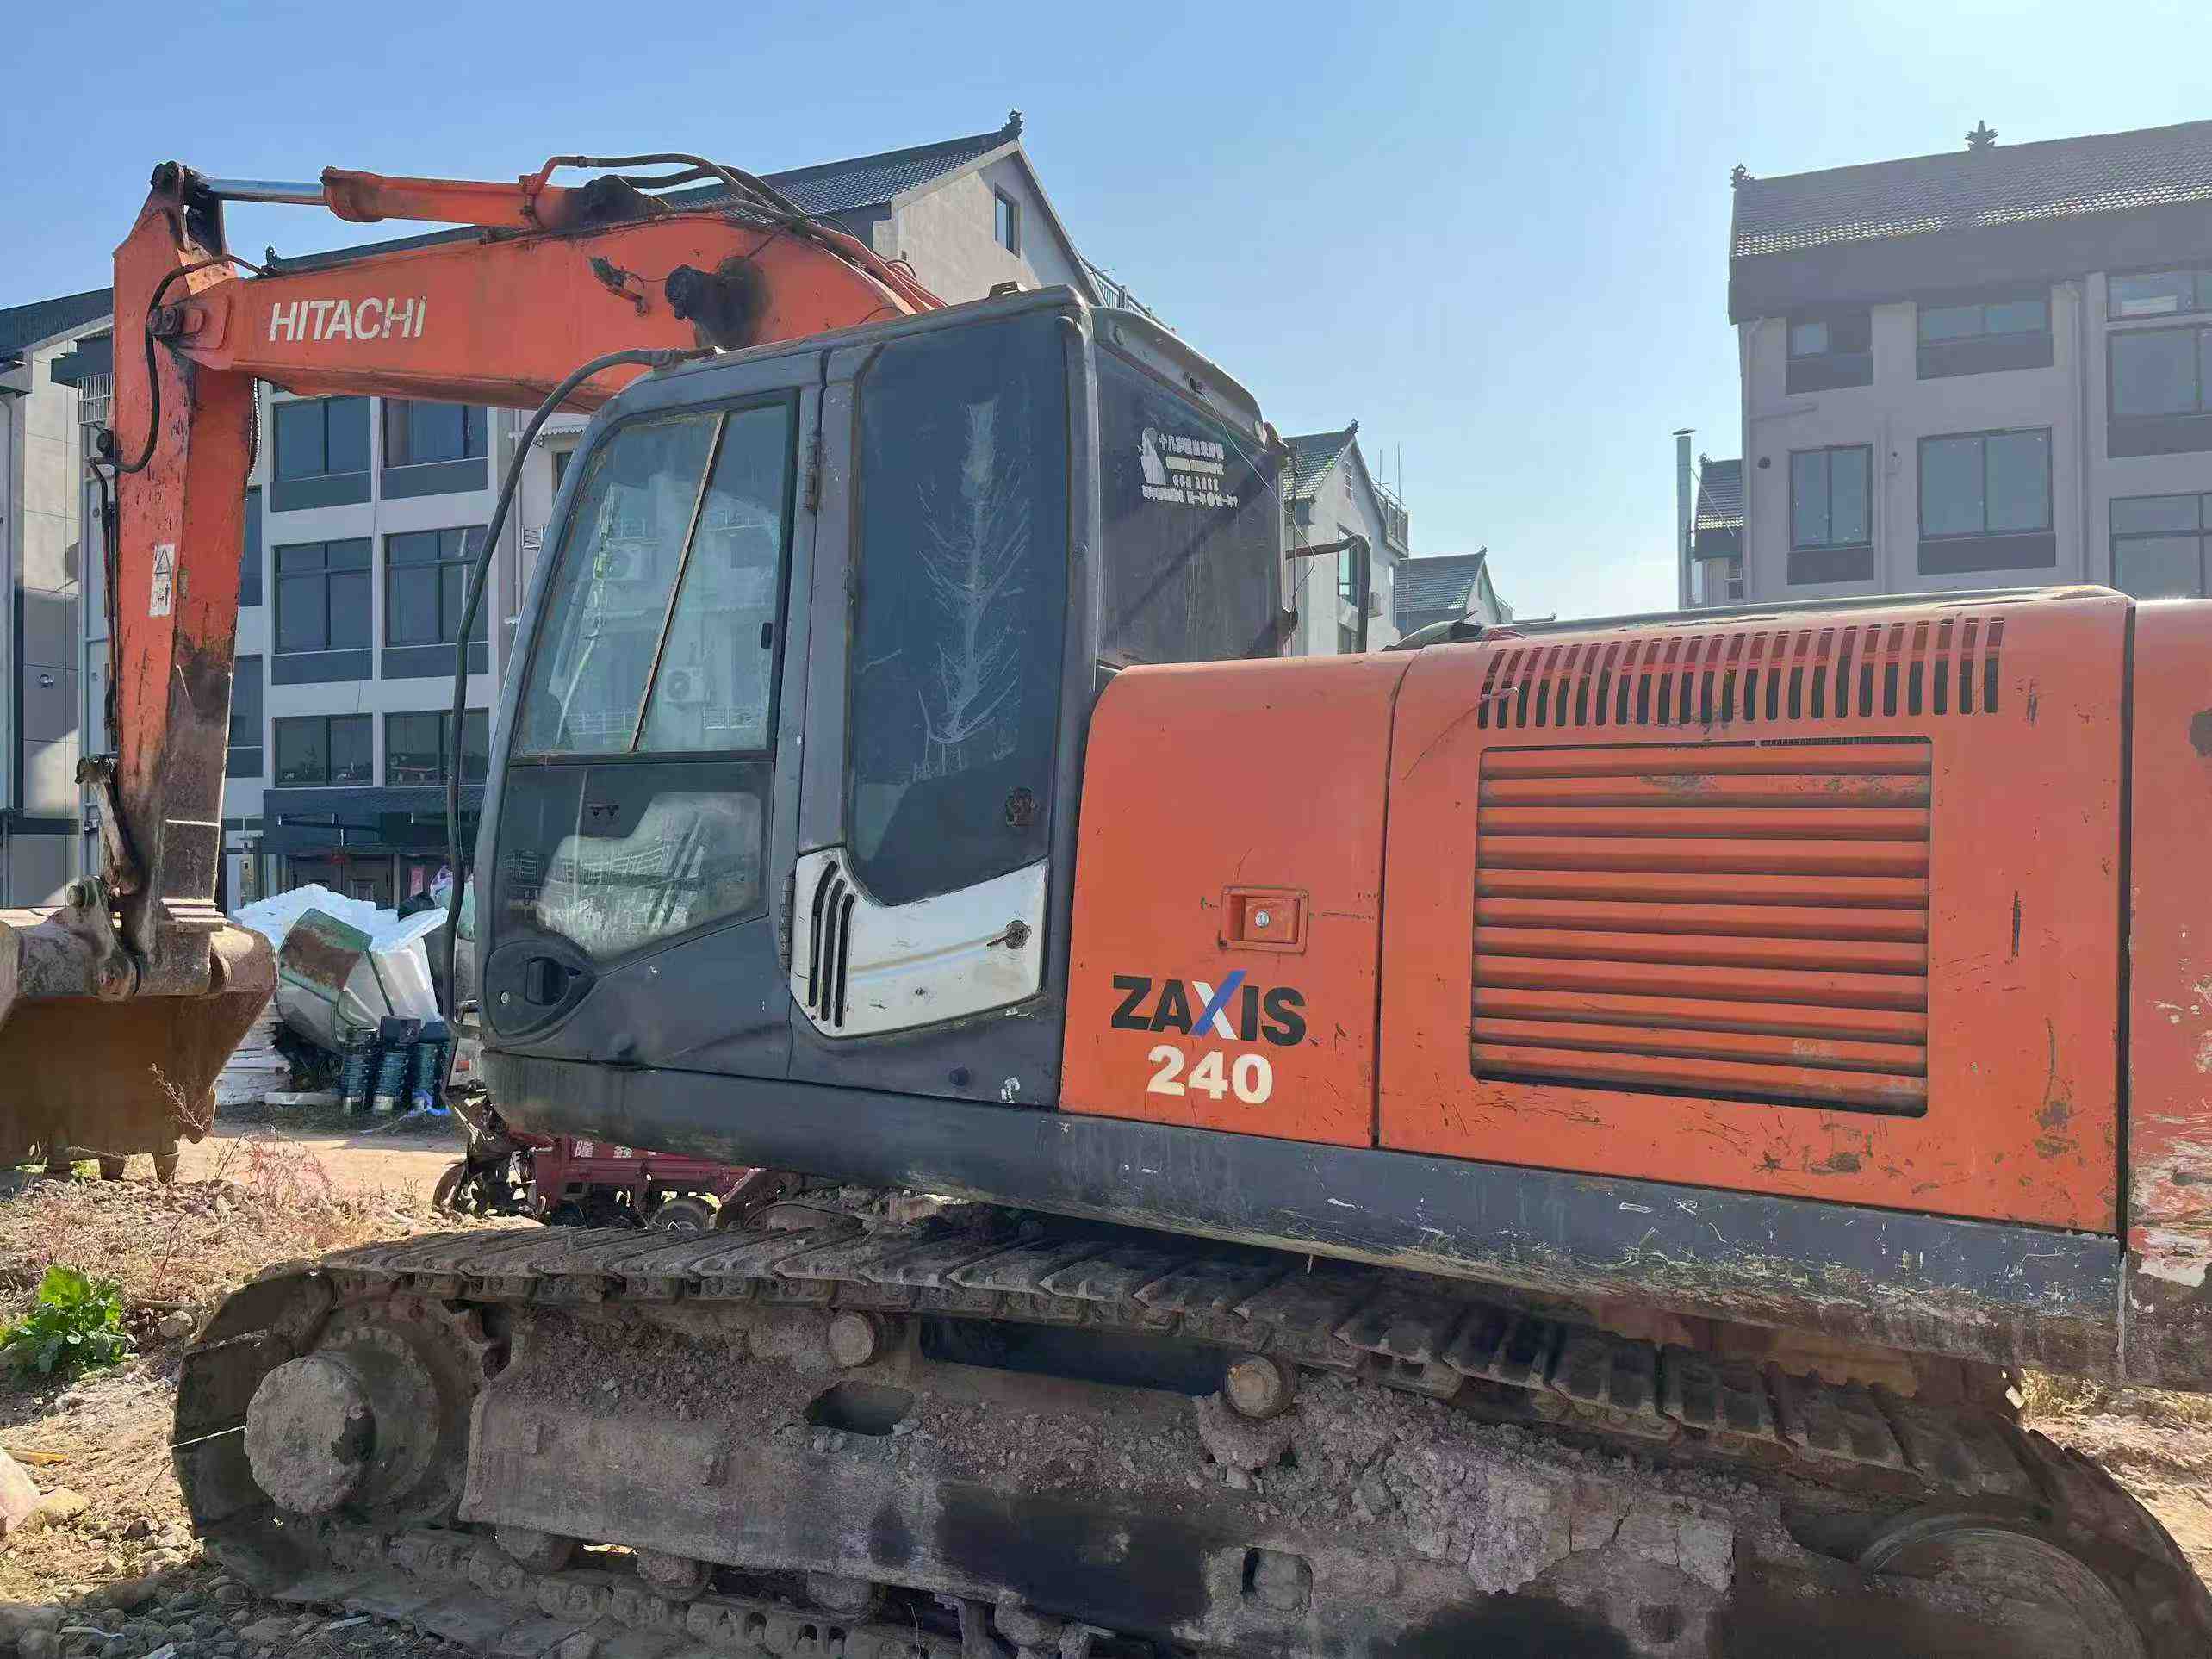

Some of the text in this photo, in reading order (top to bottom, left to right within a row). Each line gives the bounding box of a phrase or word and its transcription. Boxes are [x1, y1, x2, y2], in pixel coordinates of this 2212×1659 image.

[269, 297, 426, 341] HITACHI
[1111, 970, 1306, 1046] ZAXIS
[1146, 1045, 1273, 1104] 240
